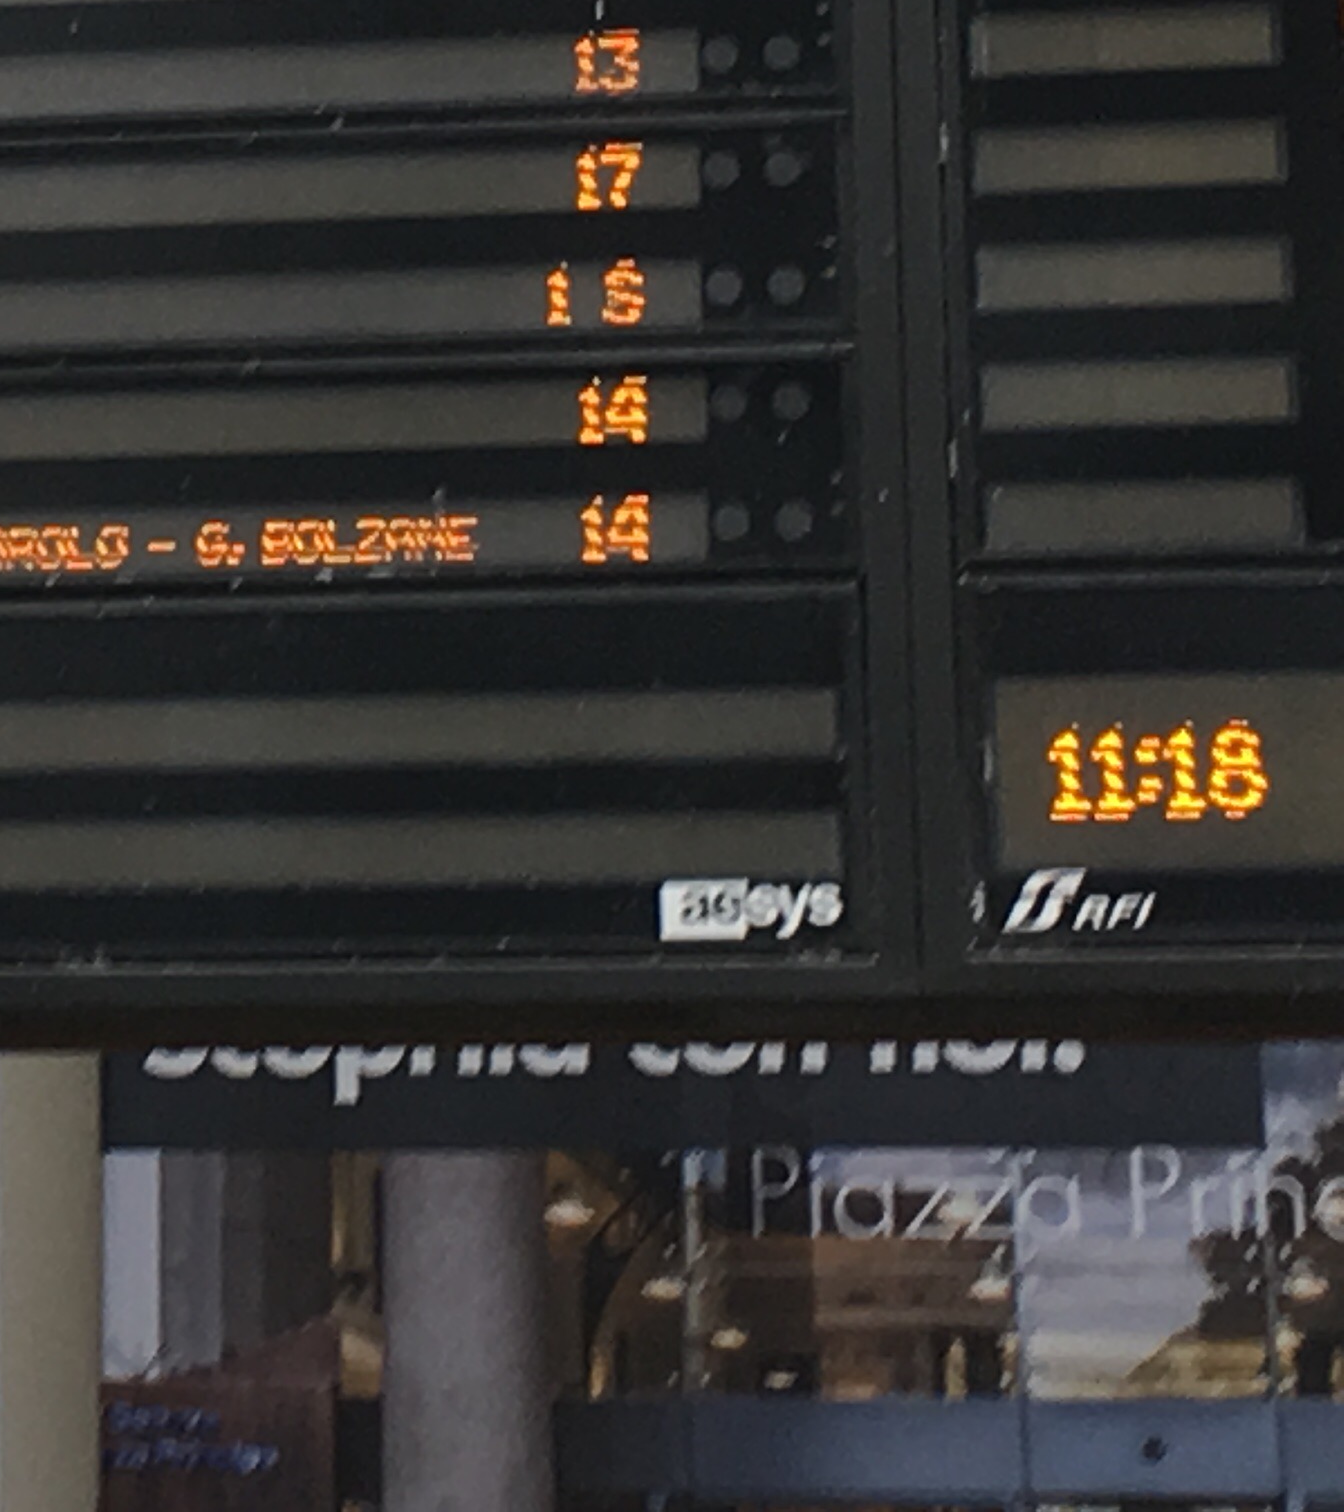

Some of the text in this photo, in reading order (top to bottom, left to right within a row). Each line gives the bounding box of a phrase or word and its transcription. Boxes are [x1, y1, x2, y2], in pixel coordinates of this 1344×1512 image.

[573, 28, 641, 95] 13
[575, 142, 643, 211] 17
[546, 264, 572, 326] 1
[578, 375, 649, 445] 14
[580, 494, 651, 564] 14
[1046, 718, 1270, 823] 11:18
